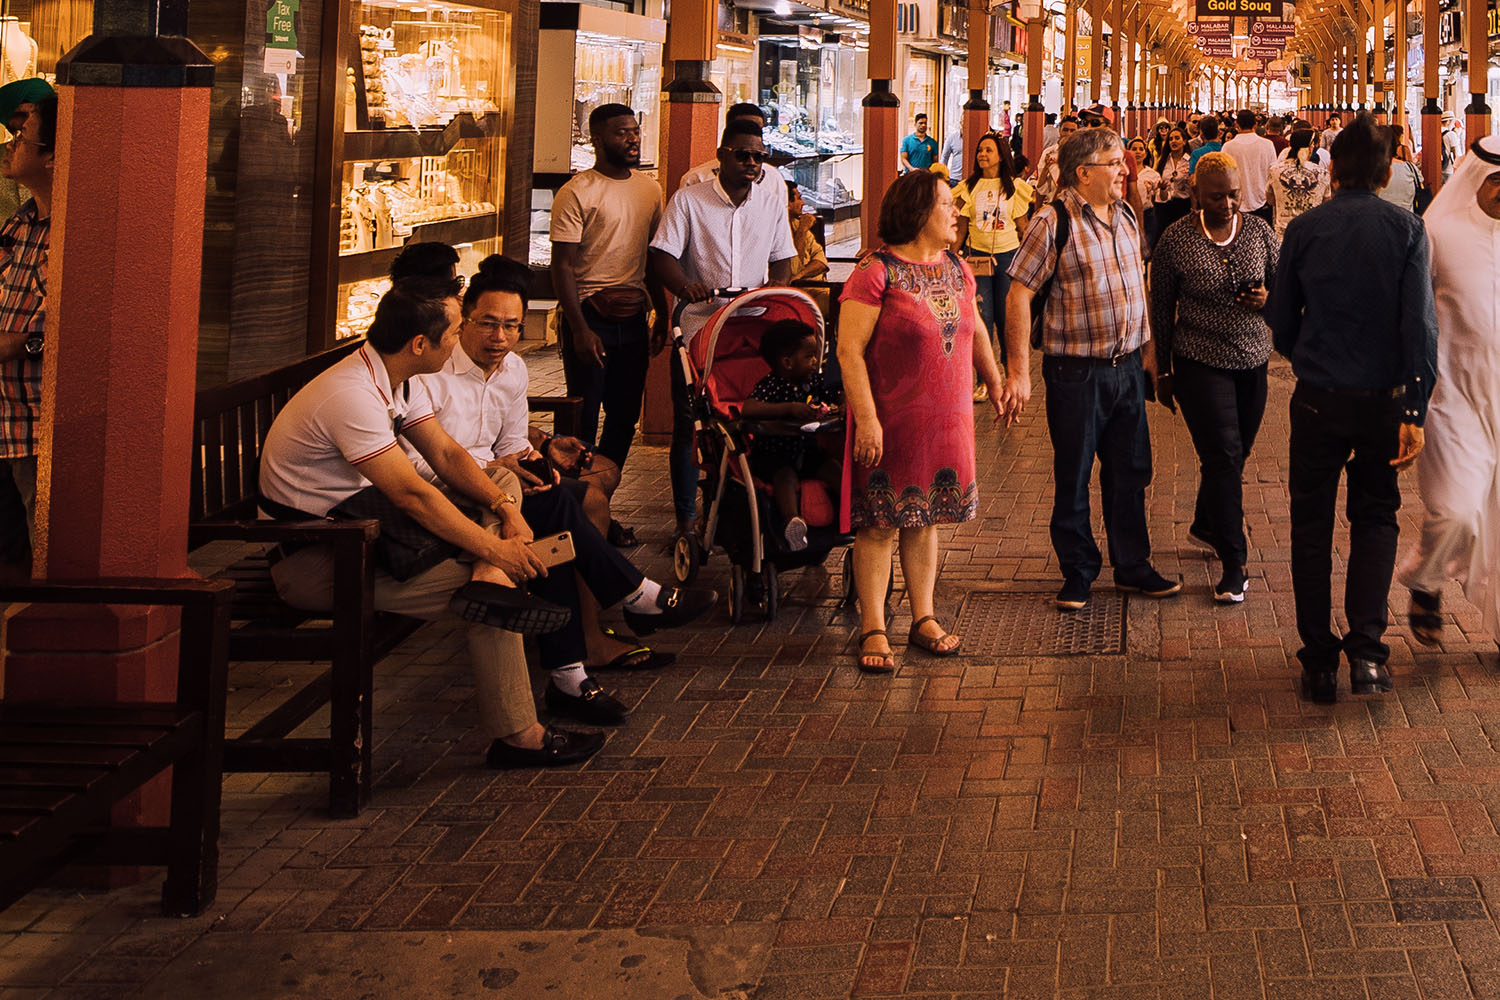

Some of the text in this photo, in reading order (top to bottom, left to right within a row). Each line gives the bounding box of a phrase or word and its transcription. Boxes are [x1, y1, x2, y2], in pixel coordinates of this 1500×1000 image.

[276, 0, 291, 16] Tax
[1207, 0, 1272, 13] Gold Souq
[273, 16, 292, 32] Free
